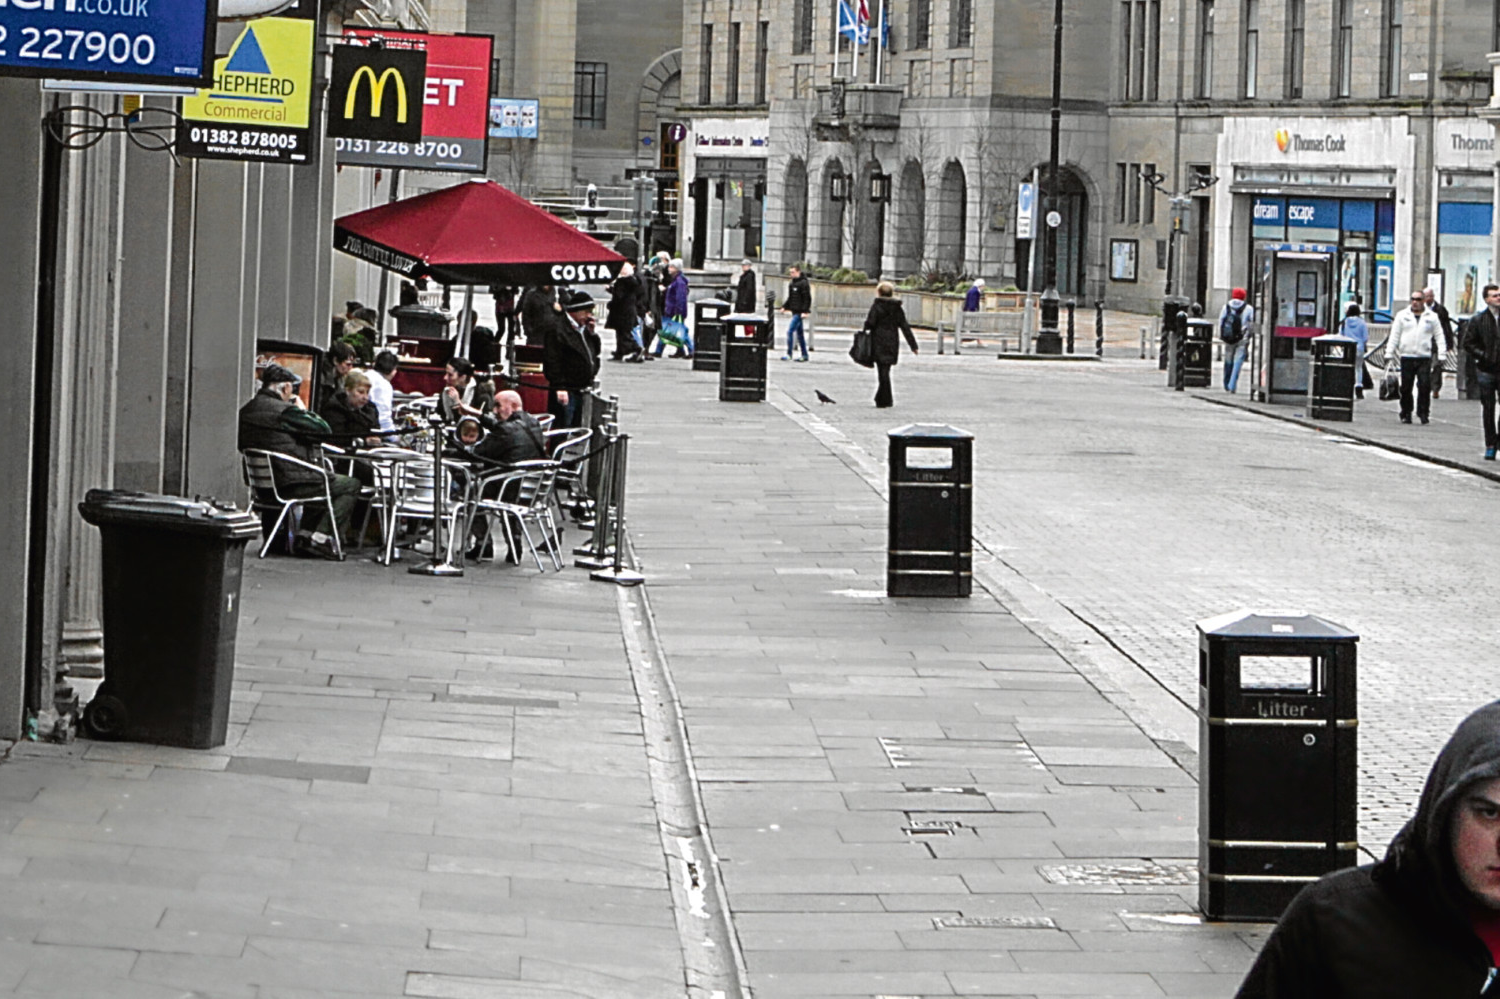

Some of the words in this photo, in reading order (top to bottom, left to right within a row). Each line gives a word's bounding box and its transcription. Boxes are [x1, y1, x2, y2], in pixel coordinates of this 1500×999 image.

[19, 27, 155, 65] 227900
[213, 74, 295, 96] HEPHERD
[424, 77, 464, 106] ET
[204, 102, 287, 121] Commercial
[190, 128, 237, 144] 01382
[241, 131, 297, 149] 878005
[1293, 134, 1324, 151] Thomas
[1325, 135, 1346, 152] Cook
[414, 141, 462, 158] 8700
[1254, 200, 1278, 220] dream
[1288, 204, 1314, 224] escape
[550, 264, 612, 281] COSTA
[1257, 701, 1307, 717] Litter
